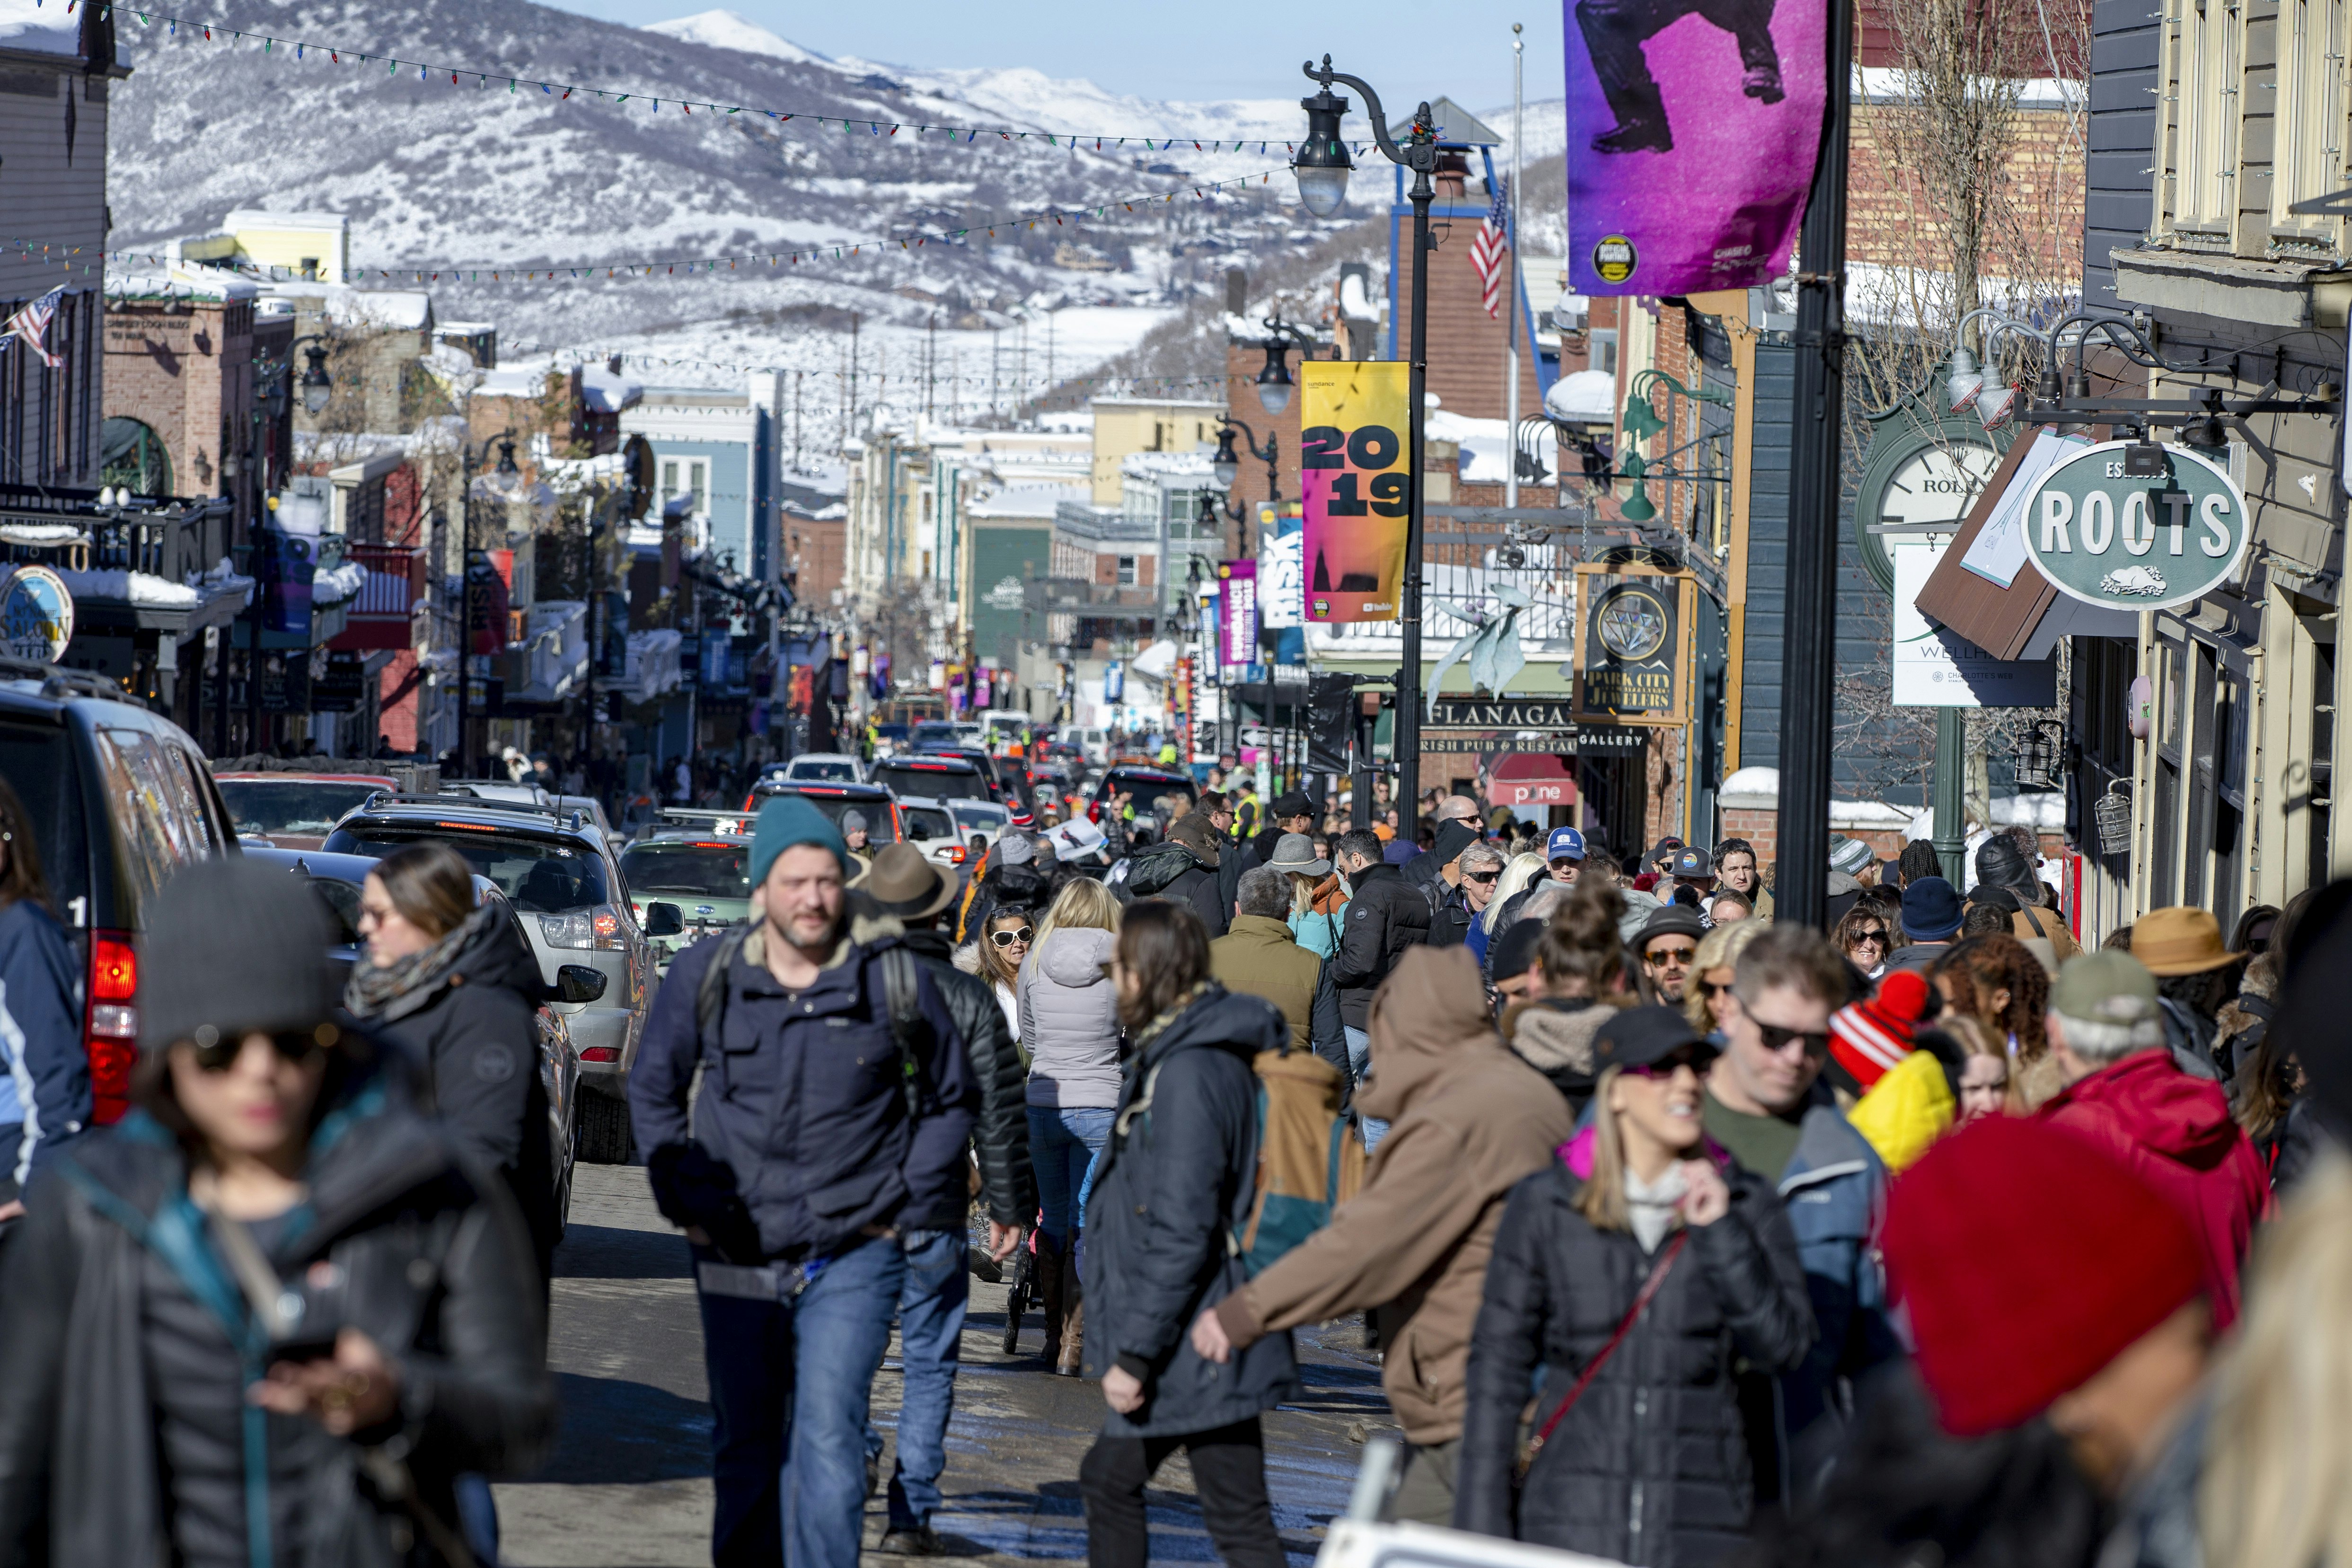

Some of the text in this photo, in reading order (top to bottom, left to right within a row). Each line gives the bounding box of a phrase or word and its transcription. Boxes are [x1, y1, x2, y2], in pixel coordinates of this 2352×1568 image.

[1713, 247, 1744, 259] CHASE
[1710, 254, 1771, 273] SAPPHIRE
[1897, 396, 1959, 432] PAK
[1302, 425, 1400, 470] 20
[2106, 462, 2132, 478] ES.
[1328, 472, 1409, 518] 19
[2041, 490, 2231, 557] ROOTS
[1264, 530, 1299, 629] RISK
[1242, 578, 1254, 610] 2019
[1374, 602, 1393, 611] YouTube
[0, 615, 71, 641] SALOON
[1229, 578, 1244, 662] SUNDANCE
[1921, 646, 1994, 659] WELLH
[1588, 671, 1670, 688] PARK CITY
[1589, 687, 1669, 707] JEWELERS
[1427, 705, 1577, 725] FLANAGA
[1463, 740, 1495, 752] PUB
[1500, 740, 1510, 754] &
[1579, 734, 1643, 746] GALLERY
[68, 895, 86, 927] 1
